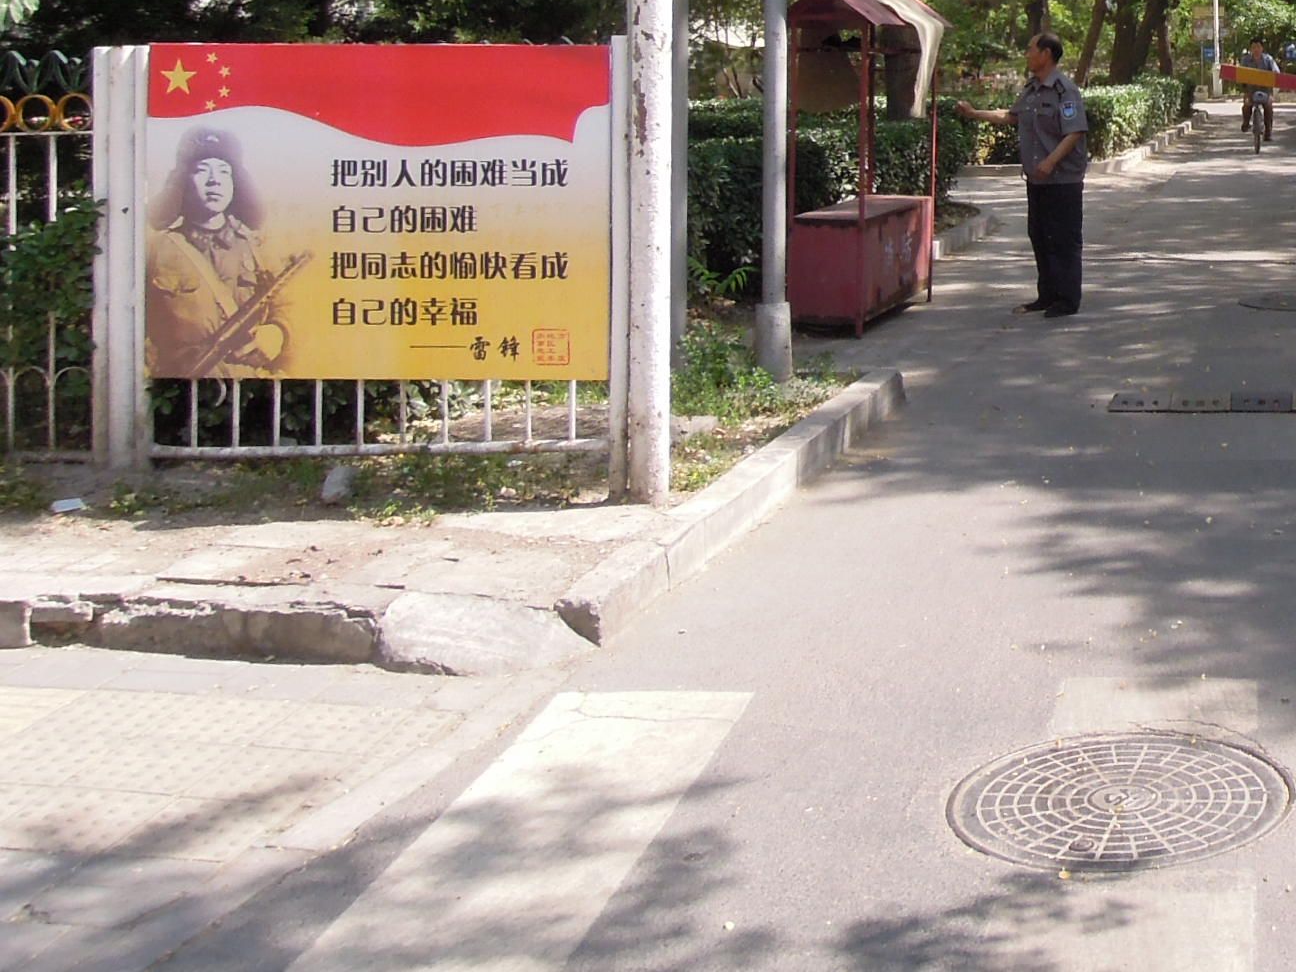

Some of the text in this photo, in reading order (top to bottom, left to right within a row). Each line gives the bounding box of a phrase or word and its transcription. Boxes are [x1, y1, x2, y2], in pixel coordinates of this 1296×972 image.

[331, 159, 569, 188] 把别人的困难当成
[332, 205, 477, 234] 自己的困难
[330, 251, 569, 280] 把同志的愉快看成
[332, 297, 478, 326] 自己的幸福
